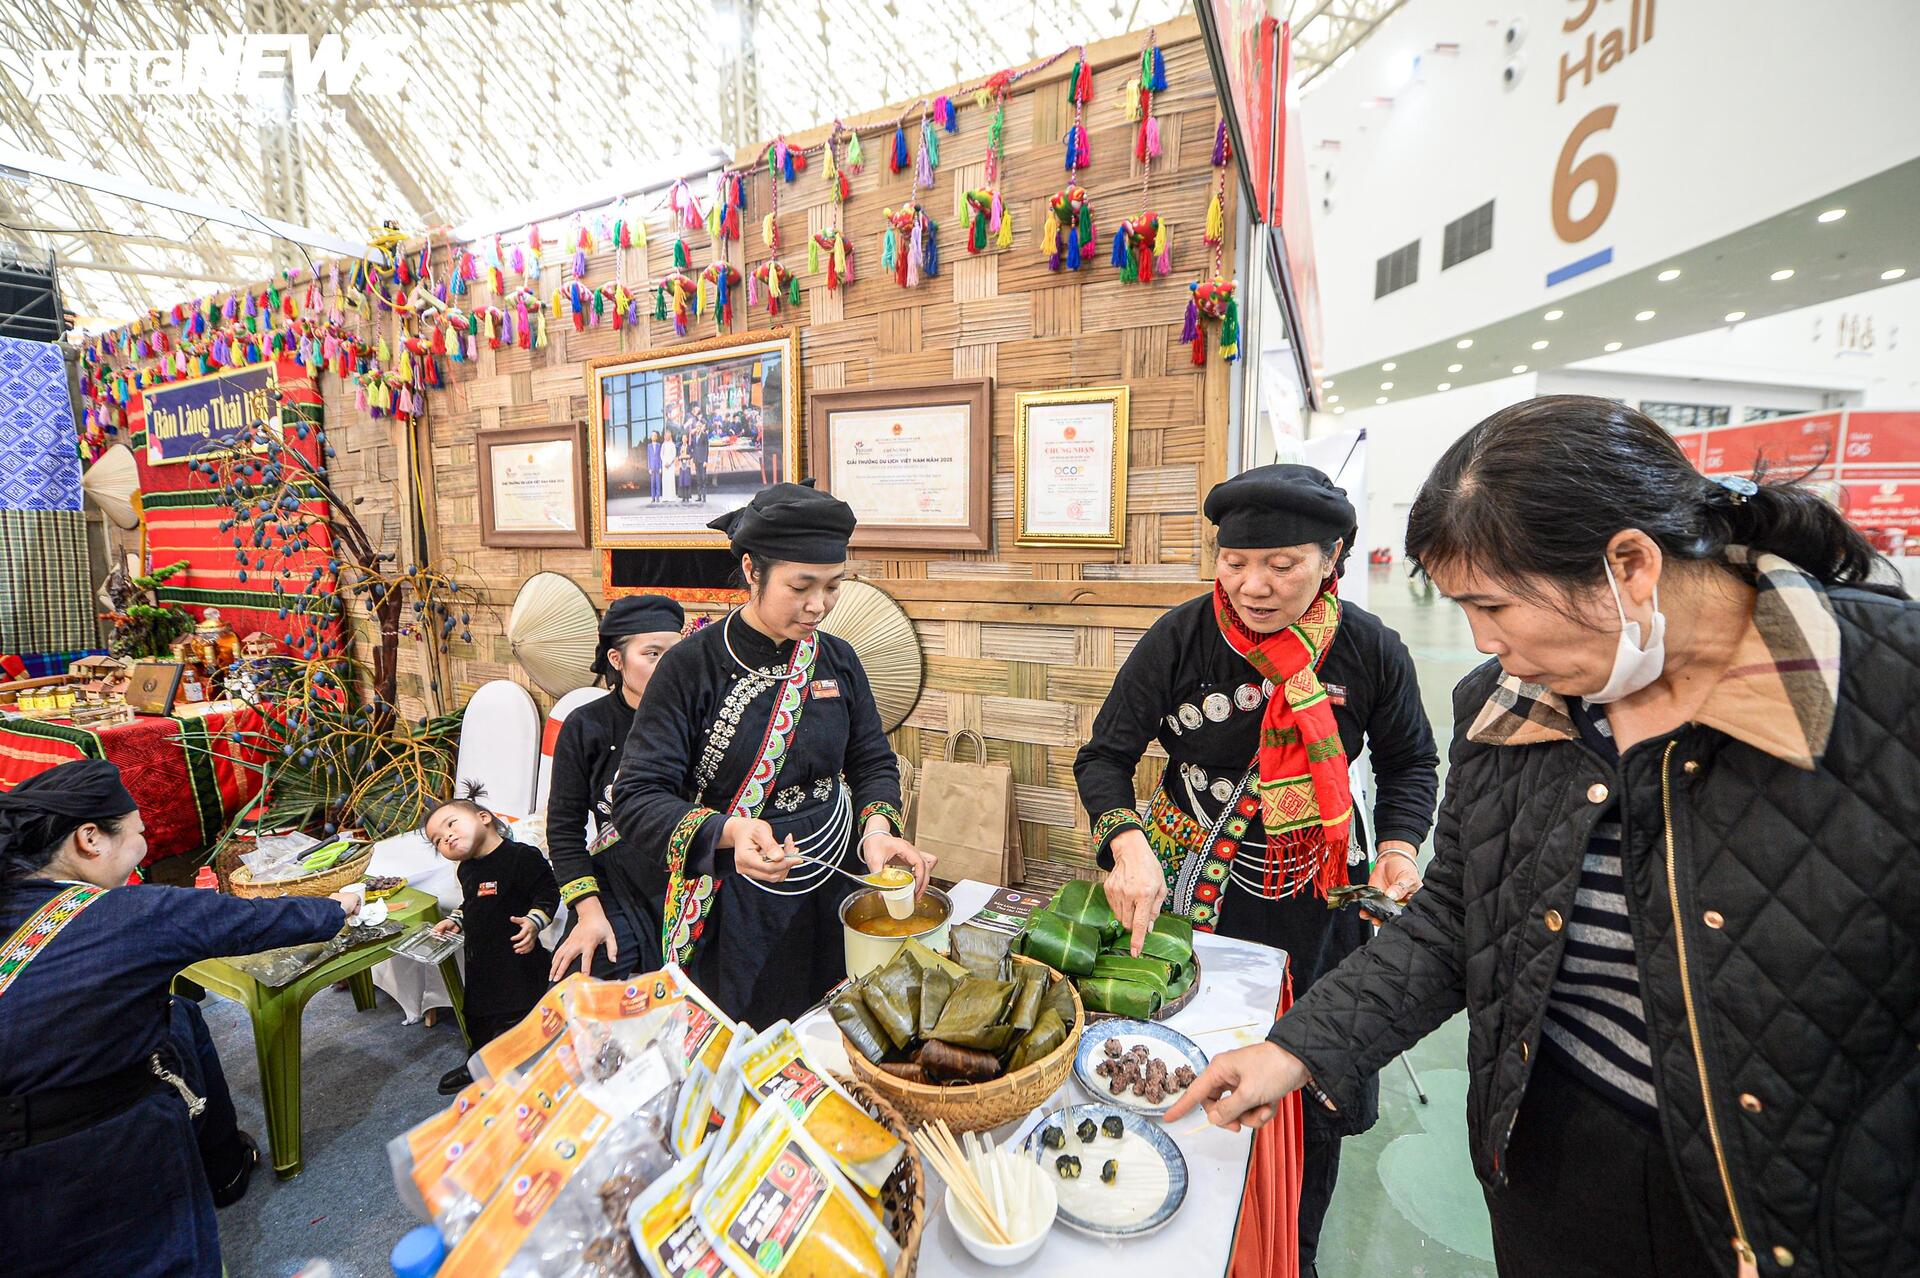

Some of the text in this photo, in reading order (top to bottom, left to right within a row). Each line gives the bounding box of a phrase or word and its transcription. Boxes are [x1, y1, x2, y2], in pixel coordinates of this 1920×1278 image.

[1557, 0, 1656, 104] Hall
[1551, 103, 1619, 243] 6
[153, 407, 178, 440] Bản
[177, 403, 212, 438] Làng
[210, 394, 243, 431] Thái
